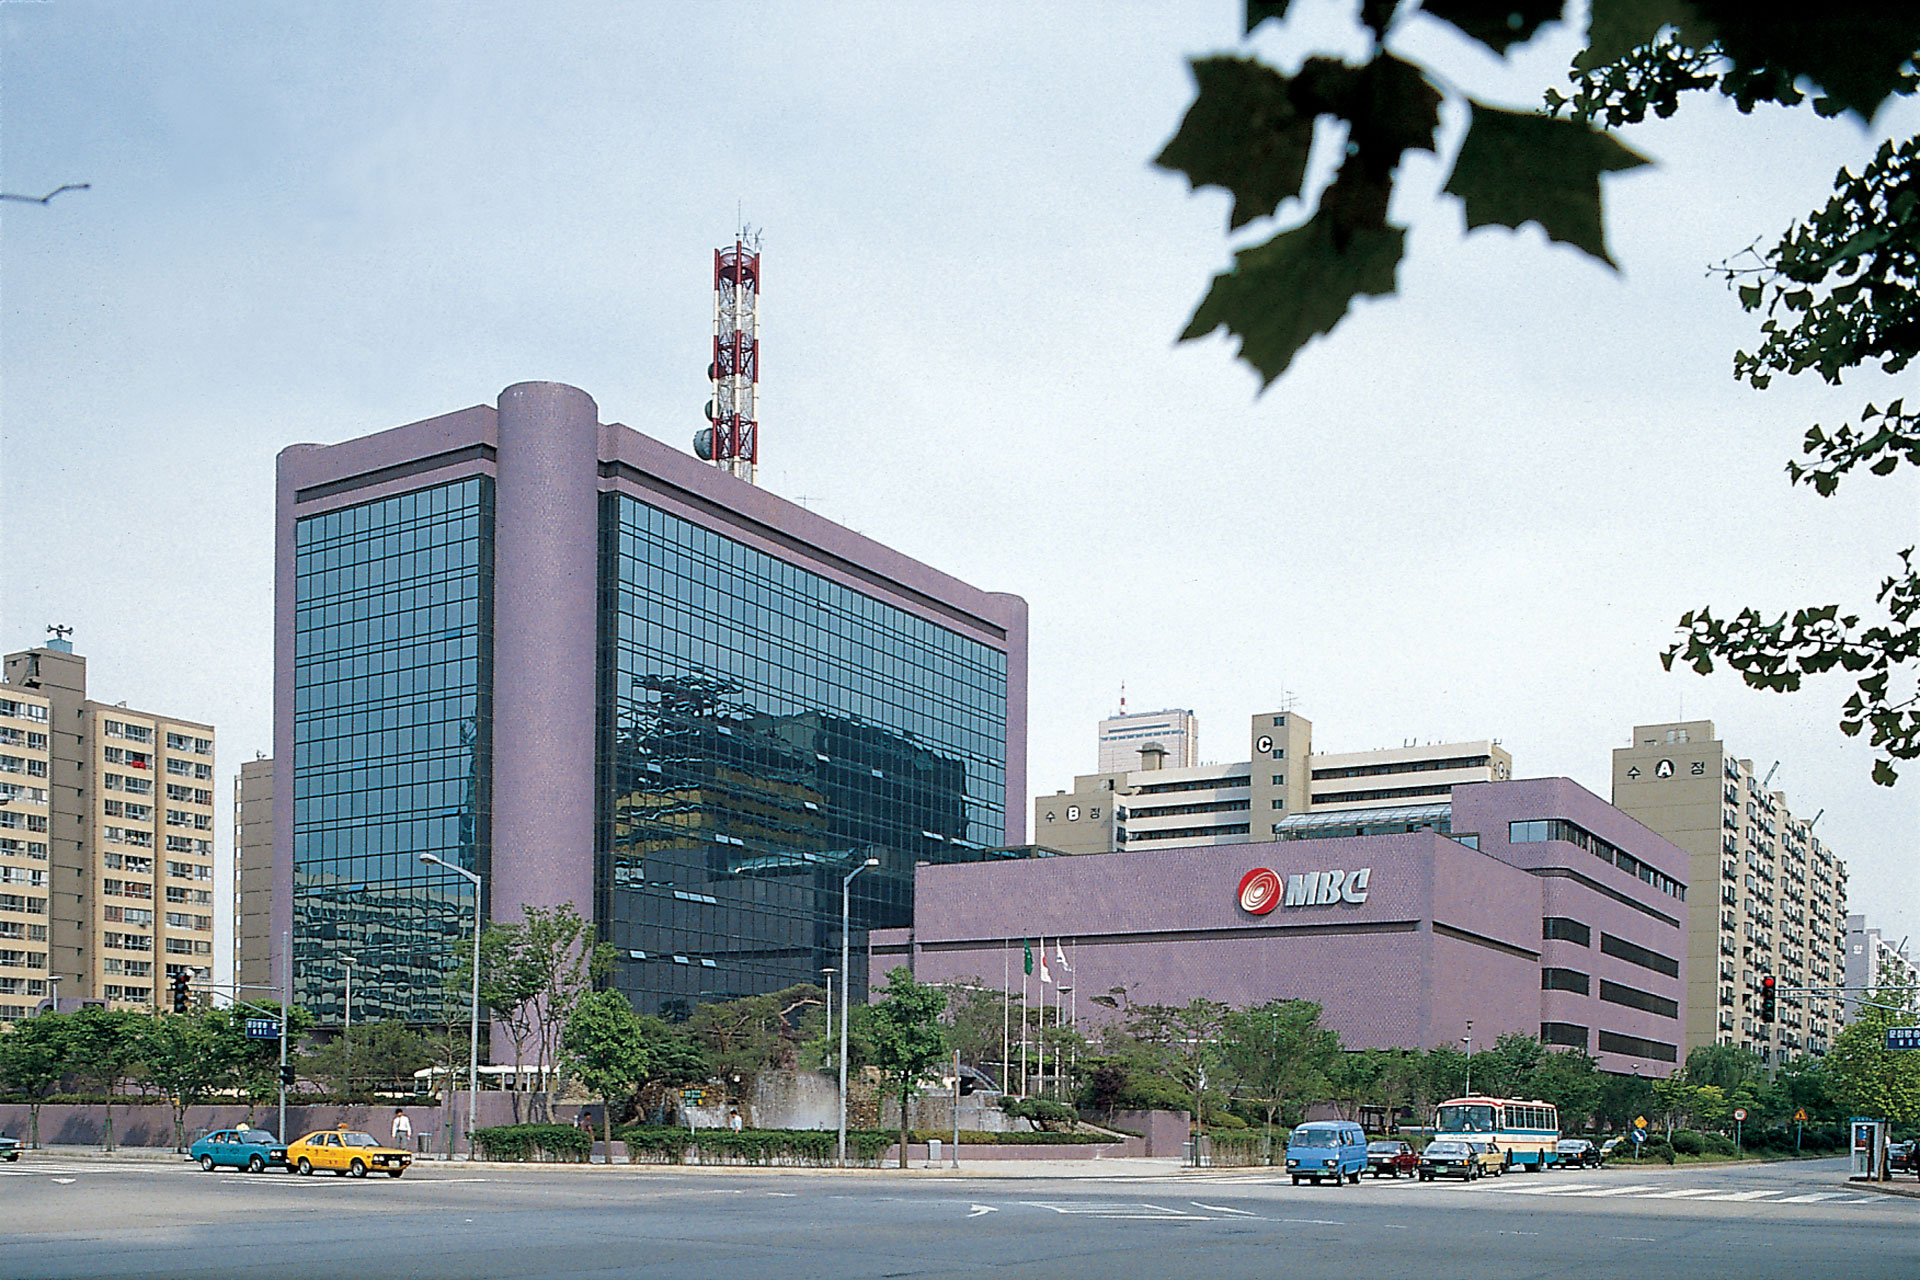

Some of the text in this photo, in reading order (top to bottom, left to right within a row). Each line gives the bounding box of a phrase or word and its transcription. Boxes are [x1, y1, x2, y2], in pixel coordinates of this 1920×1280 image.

[1257, 736, 1272, 753] C
[1627, 760, 1704, 780] 수 A 정
[1045, 805, 1101, 823] 수 B 정
[1285, 868, 1371, 906] MBC
